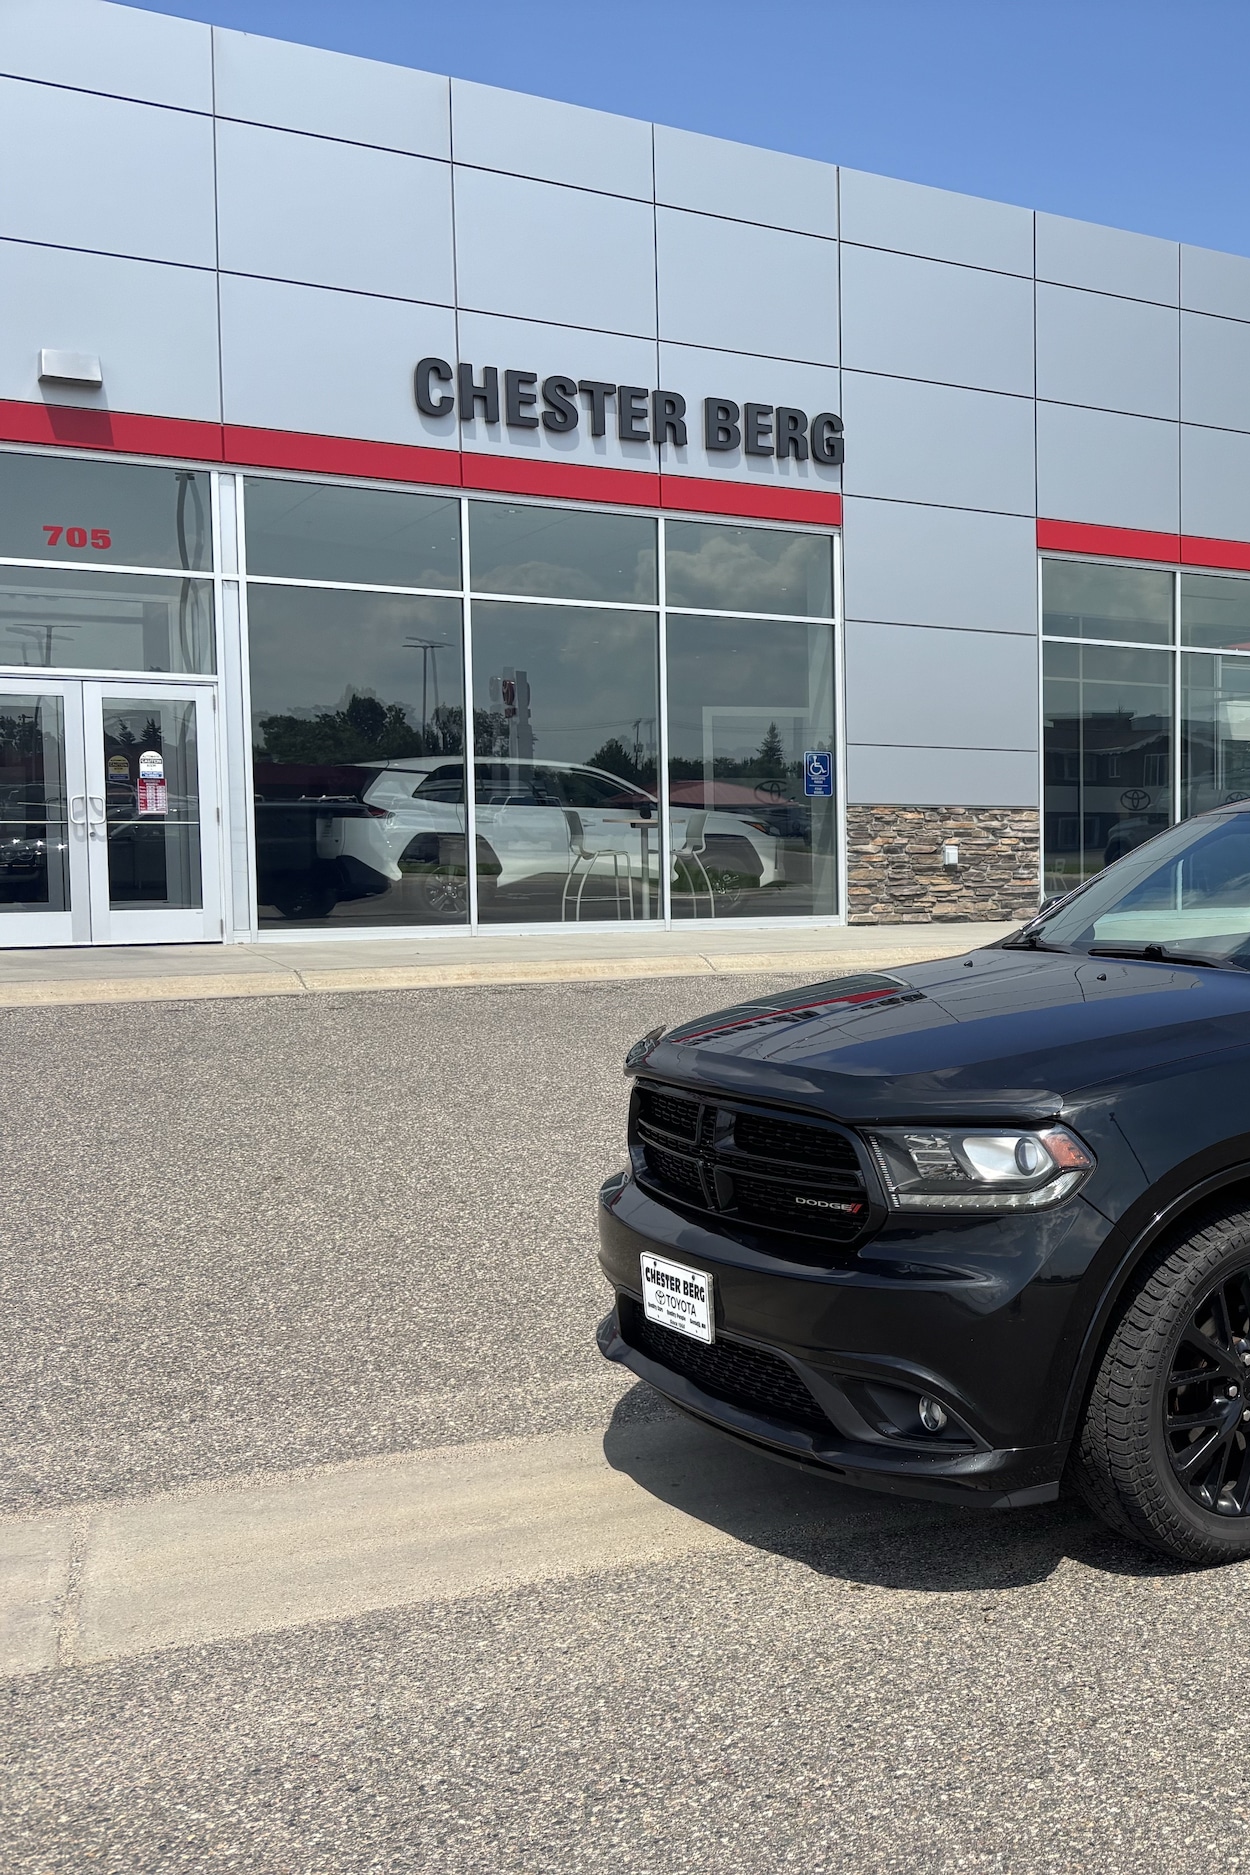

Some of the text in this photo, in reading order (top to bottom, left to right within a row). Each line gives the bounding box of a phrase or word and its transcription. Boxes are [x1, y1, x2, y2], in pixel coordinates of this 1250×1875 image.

[414, 357, 846, 465] CHESTER BERG
[42, 525, 112, 550] 705
[795, 1196, 853, 1212] DODGE
[645, 1266, 705, 1303] CHESTER BERG
[666, 1294, 697, 1317] TOYOTA
